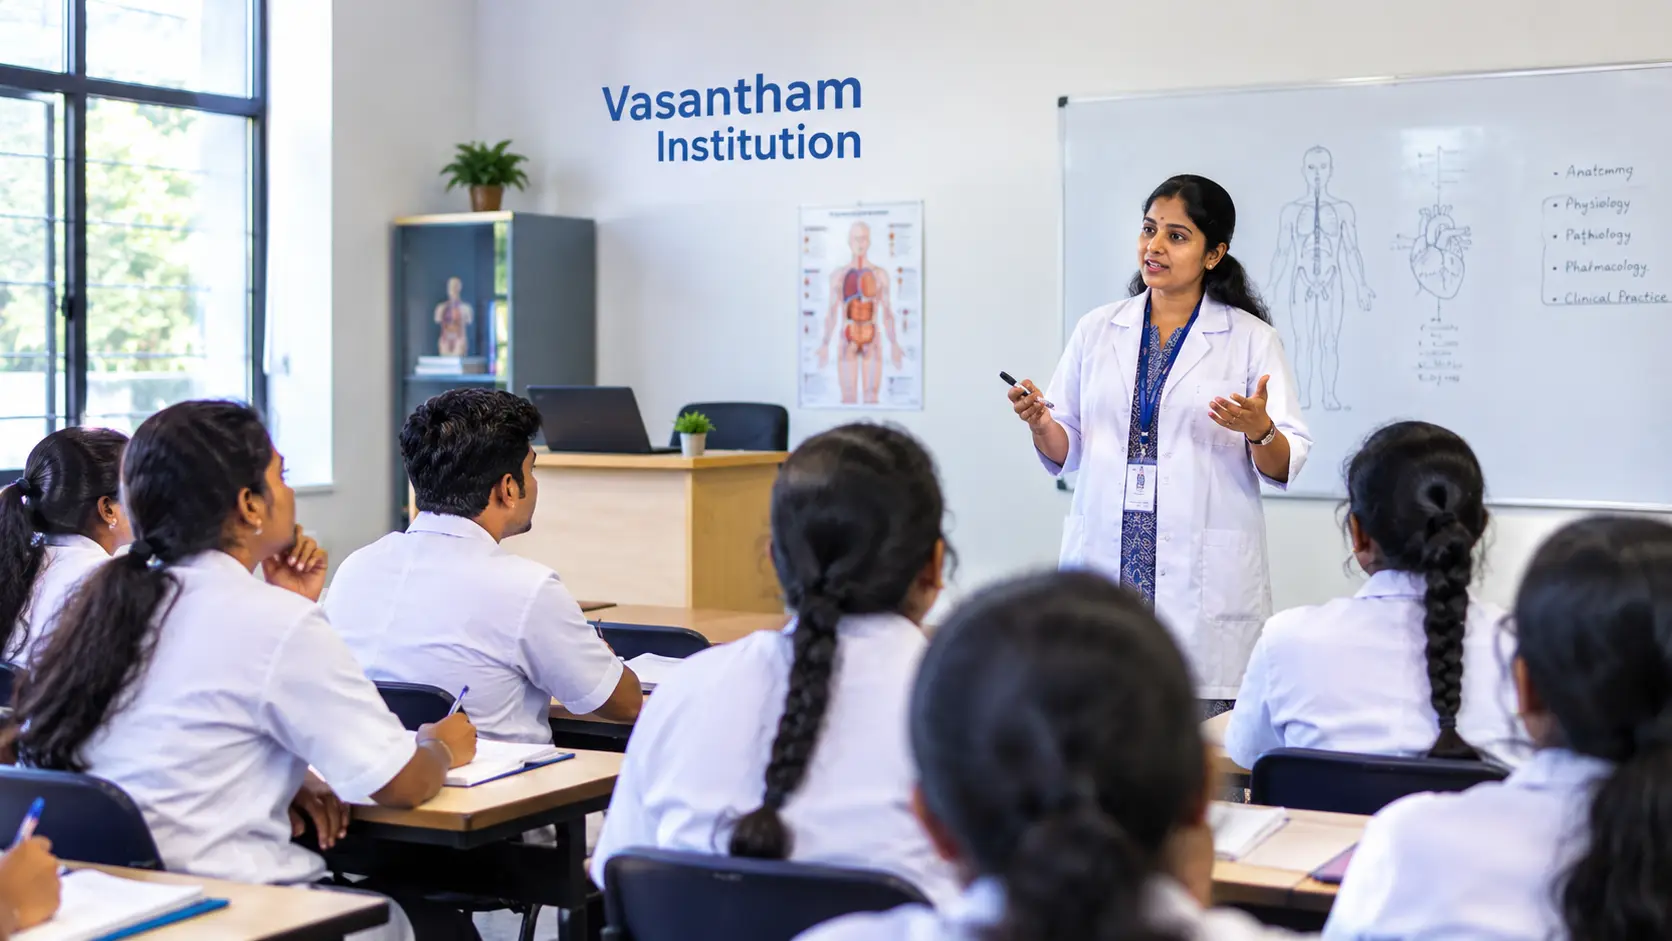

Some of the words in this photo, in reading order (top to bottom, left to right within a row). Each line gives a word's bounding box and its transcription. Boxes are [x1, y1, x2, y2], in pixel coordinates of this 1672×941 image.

[601, 73, 862, 122] Vasantham
[656, 123, 862, 163] Institution
[1565, 197, 1631, 216] Physiology
[1564, 291, 1612, 305] Clinical
[1618, 290, 1669, 305] Practice
